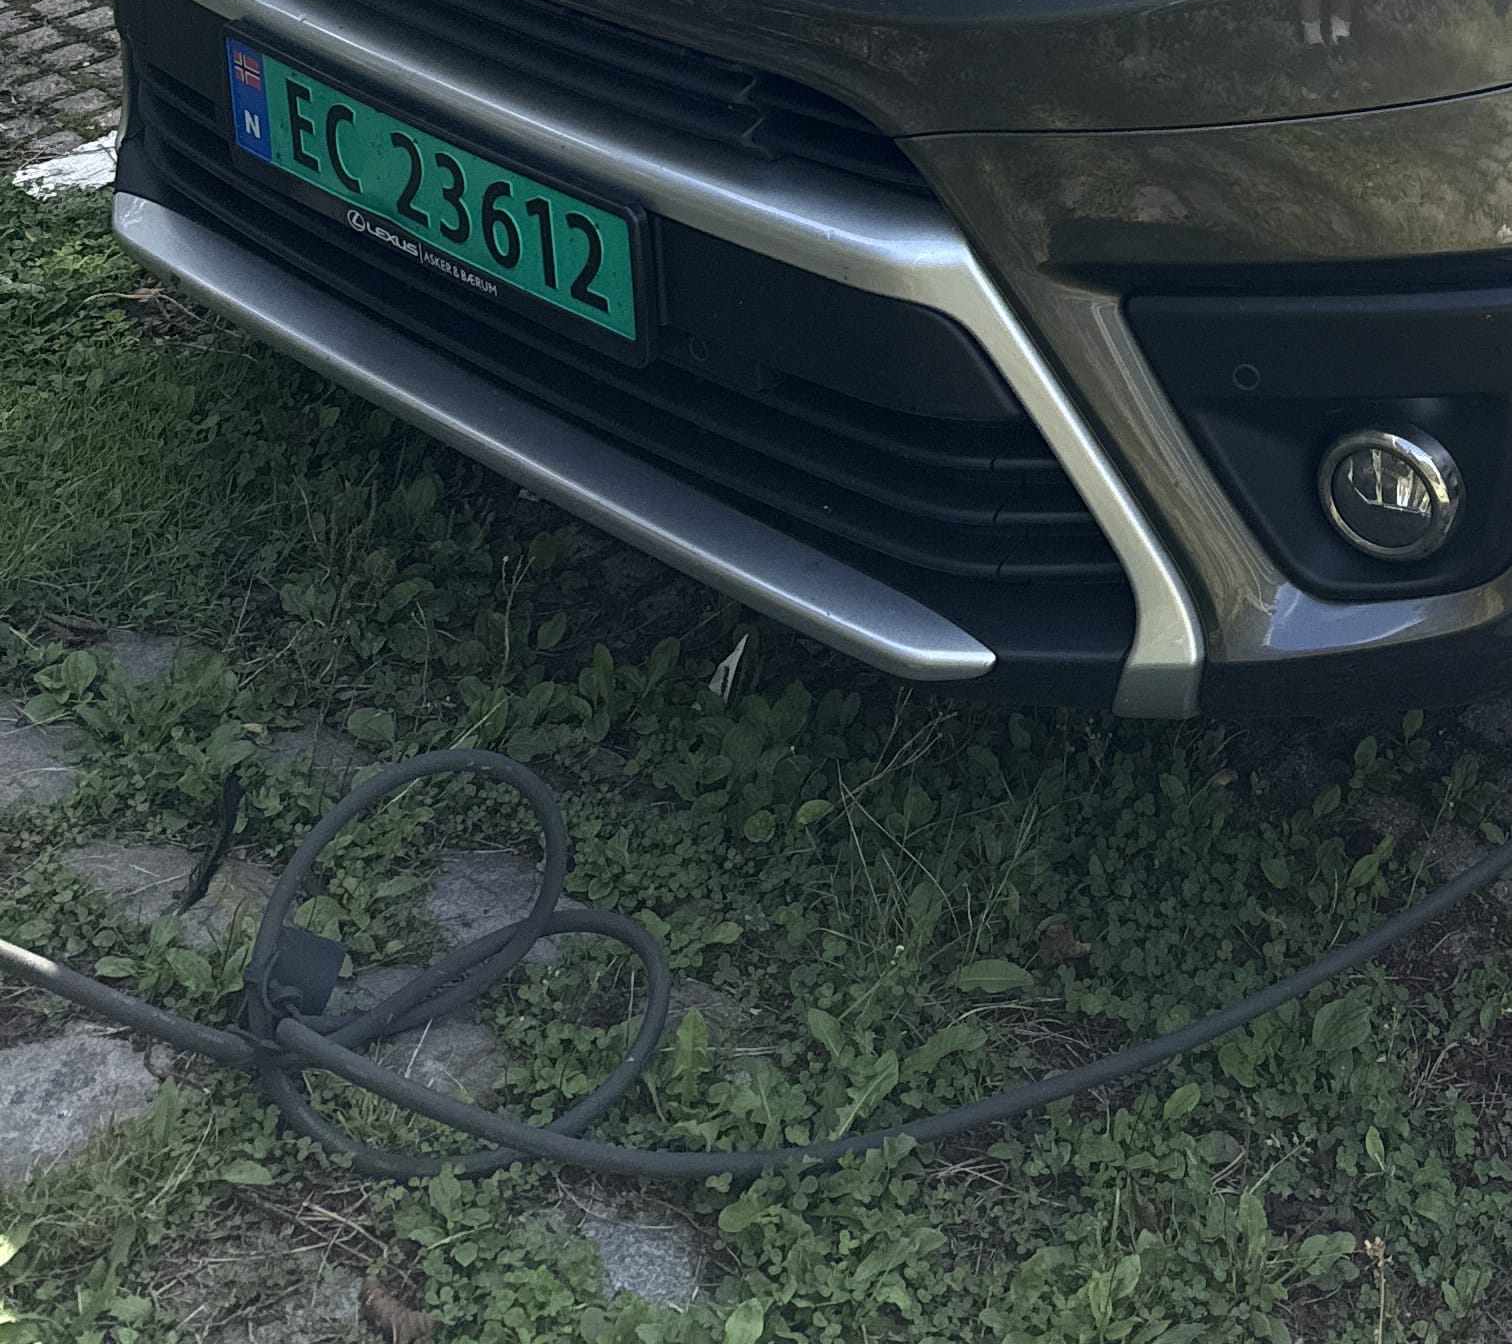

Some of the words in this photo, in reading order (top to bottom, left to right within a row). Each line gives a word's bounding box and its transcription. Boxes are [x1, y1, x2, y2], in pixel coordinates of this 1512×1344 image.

[244, 110, 261, 139] N
[286, 78, 363, 194] EC
[390, 132, 609, 313] 23612
[366, 221, 419, 257] LEXUS
[423, 252, 452, 275] ASKER
[452, 266, 460, 279] &
[461, 270, 498, 297] BÆRUM
